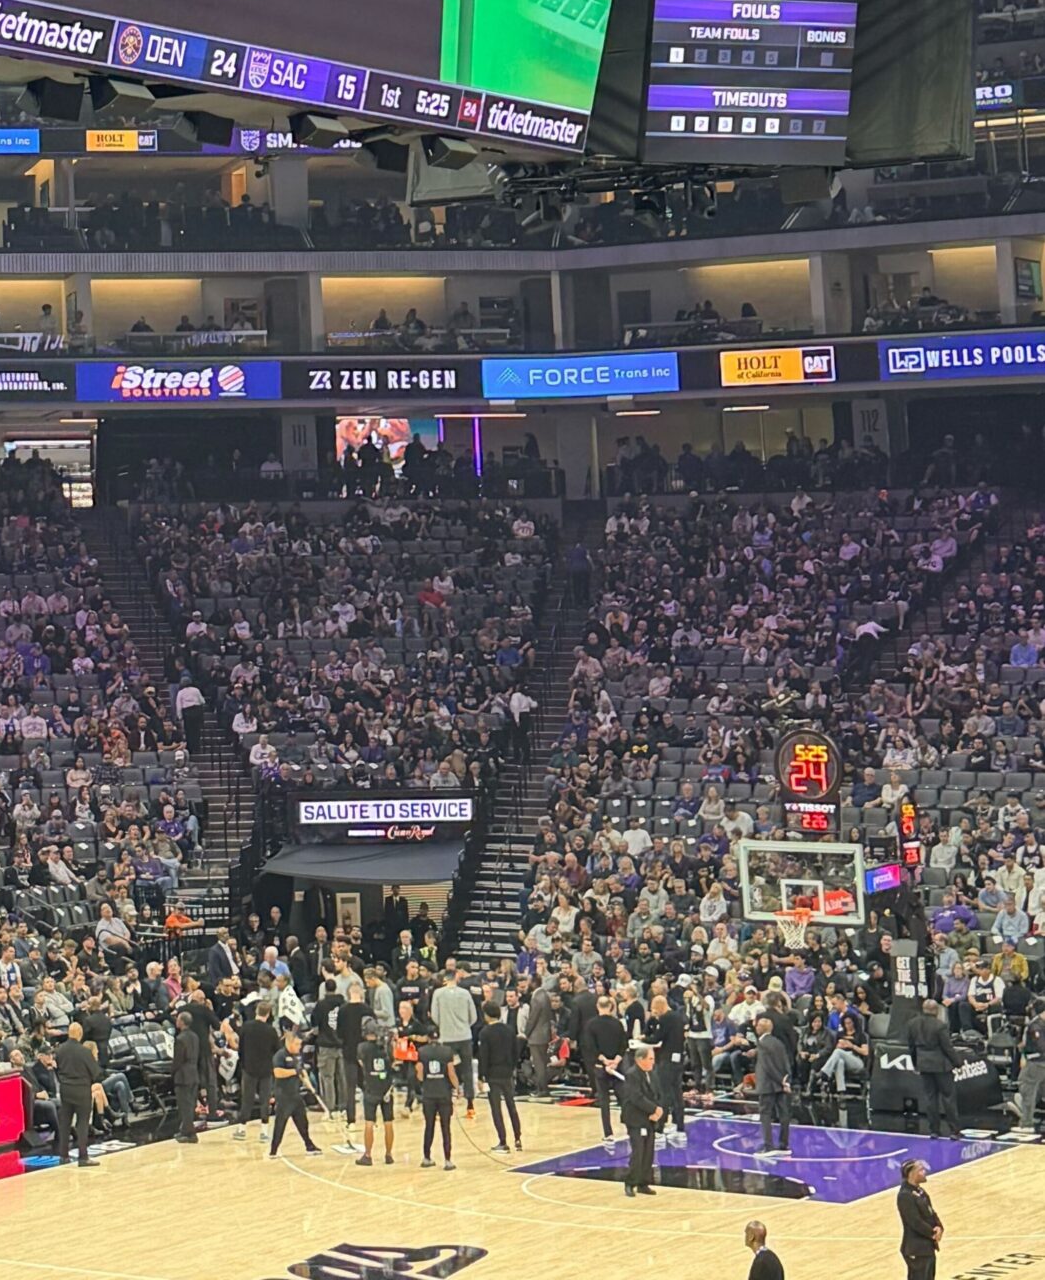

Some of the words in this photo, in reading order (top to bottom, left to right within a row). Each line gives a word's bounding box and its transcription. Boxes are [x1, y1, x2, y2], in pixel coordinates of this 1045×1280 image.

[145, 35, 185, 67] DEN
[211, 49, 236, 78] 24
[270, 58, 306, 88] SAC
[337, 74, 357, 99] 15
[380, 83, 400, 108] 1st
[416, 90, 449, 117] 5:25
[464, 101, 476, 117] 24
[489, 102, 583, 145] ticketmaster
[713, 92, 787, 107] TIMEOUTS
[15, 138, 30, 146] Inc
[737, 356, 781, 371] HOLT
[805, 356, 830, 372] CAT
[926, 348, 984, 367] WELLS
[991, 345, 1045, 364] POOLS
[112, 366, 213, 389] iStreet
[340, 370, 377, 390] ZEN
[529, 366, 610, 385] FORCE
[614, 369, 649, 379] Trans
[652, 366, 670, 377] Inc
[746, 370, 781, 379] California
[122, 388, 211, 397] SOLUTIONS
[861, 410, 878, 432] 112
[795, 745, 827, 761] 5:25
[790, 761, 827, 791] 24
[305, 804, 369, 820] SALUTE
[372, 803, 395, 819] TO
[400, 802, 468, 818] SERVICE
